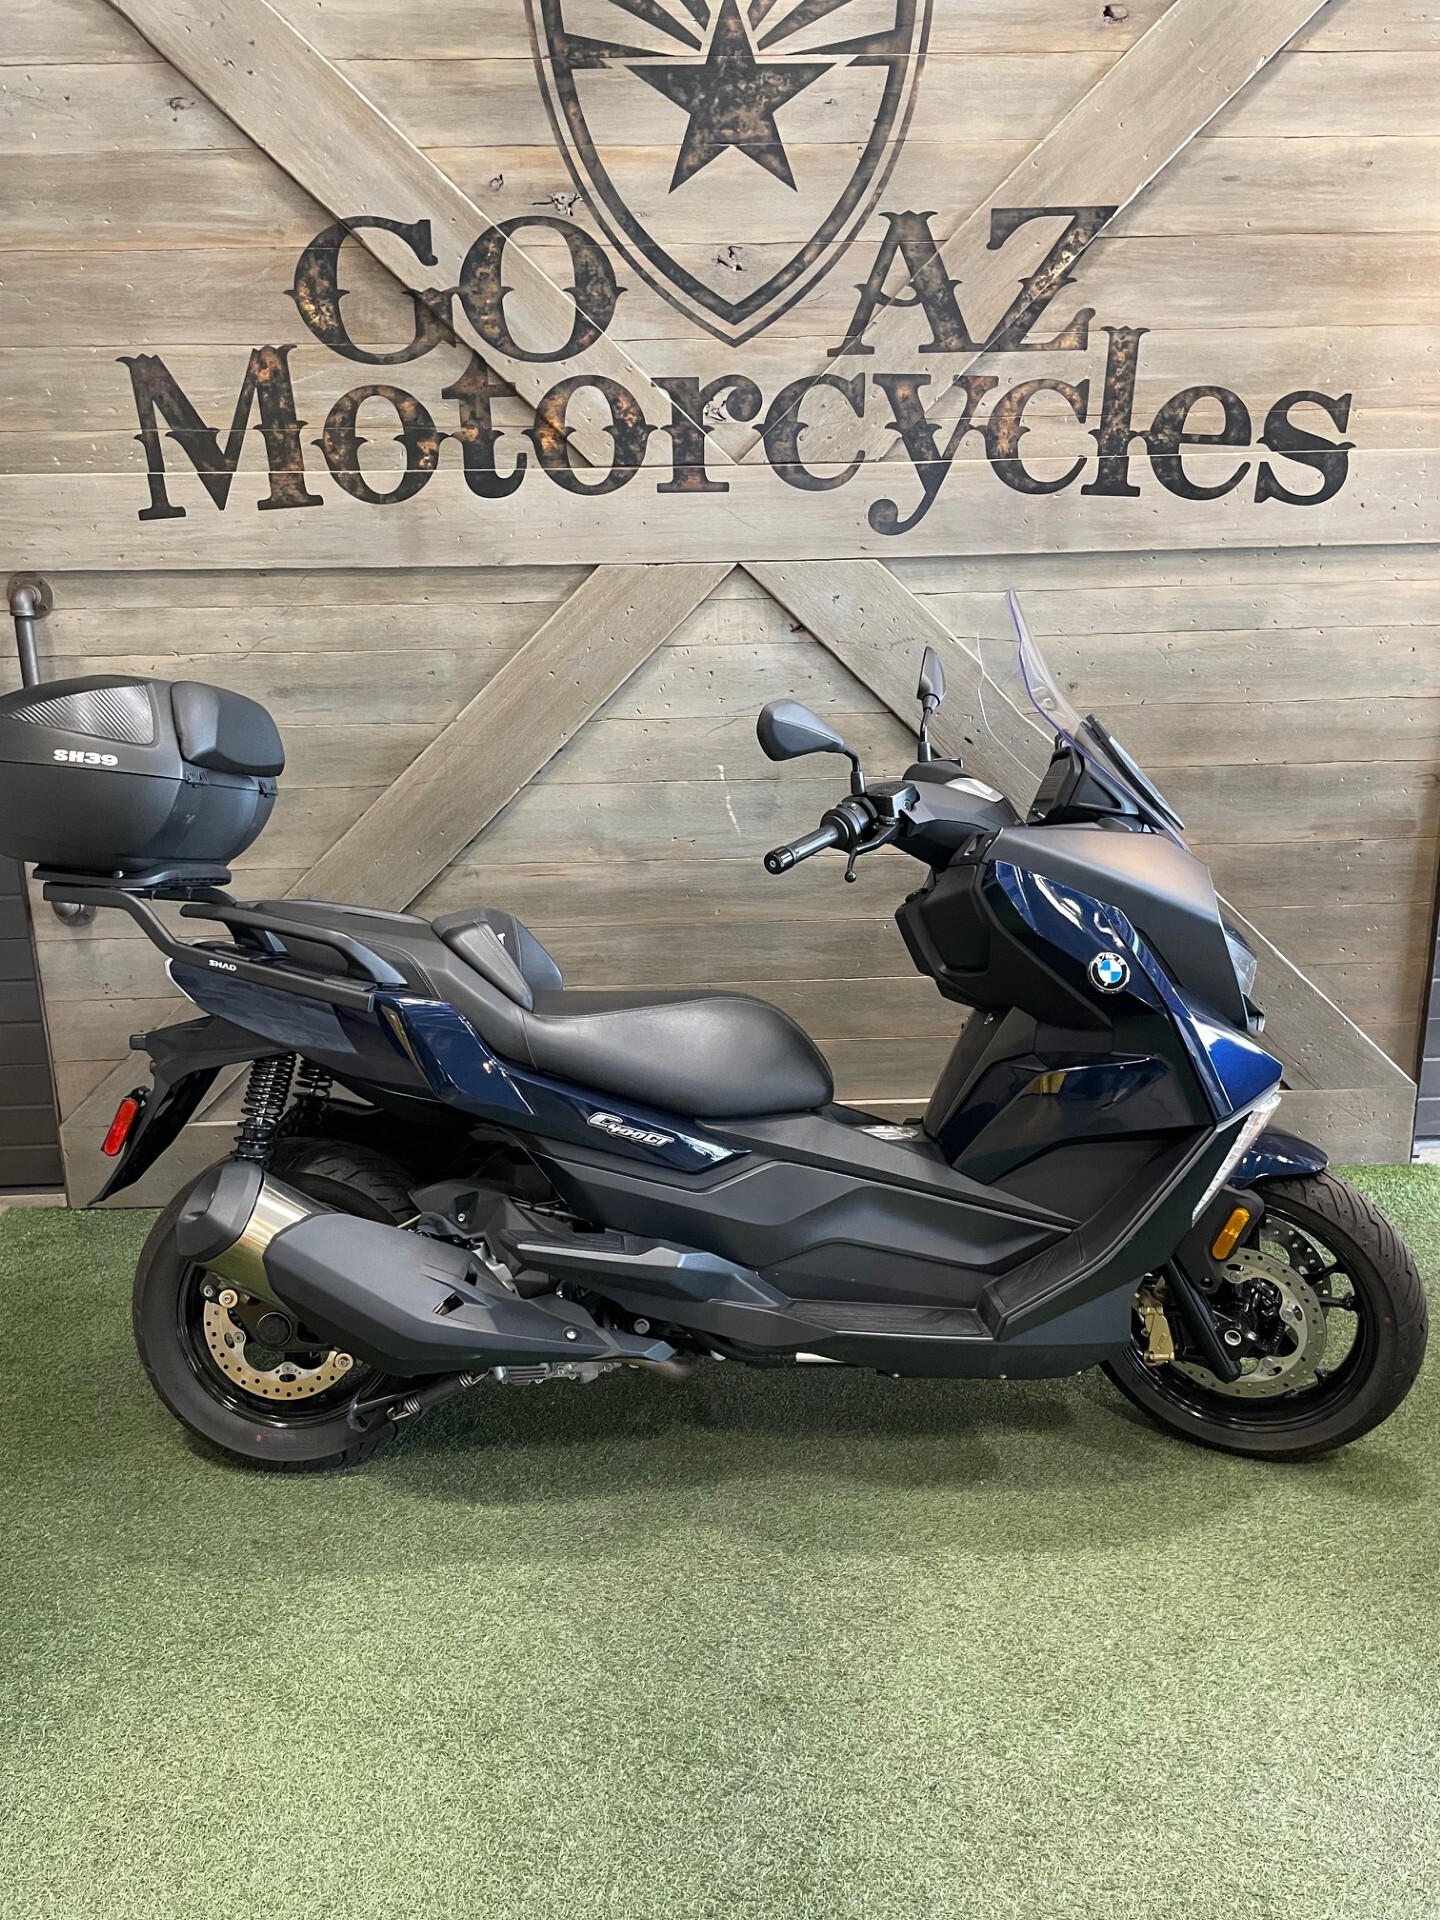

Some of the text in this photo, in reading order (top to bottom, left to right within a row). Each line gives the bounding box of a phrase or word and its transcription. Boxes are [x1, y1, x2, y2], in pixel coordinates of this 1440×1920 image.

[283, 205, 1119, 365] GO AZ
[116, 325, 1356, 536] Motorcycles
[53, 749, 118, 766] SH39
[208, 959, 237, 971] SHAD
